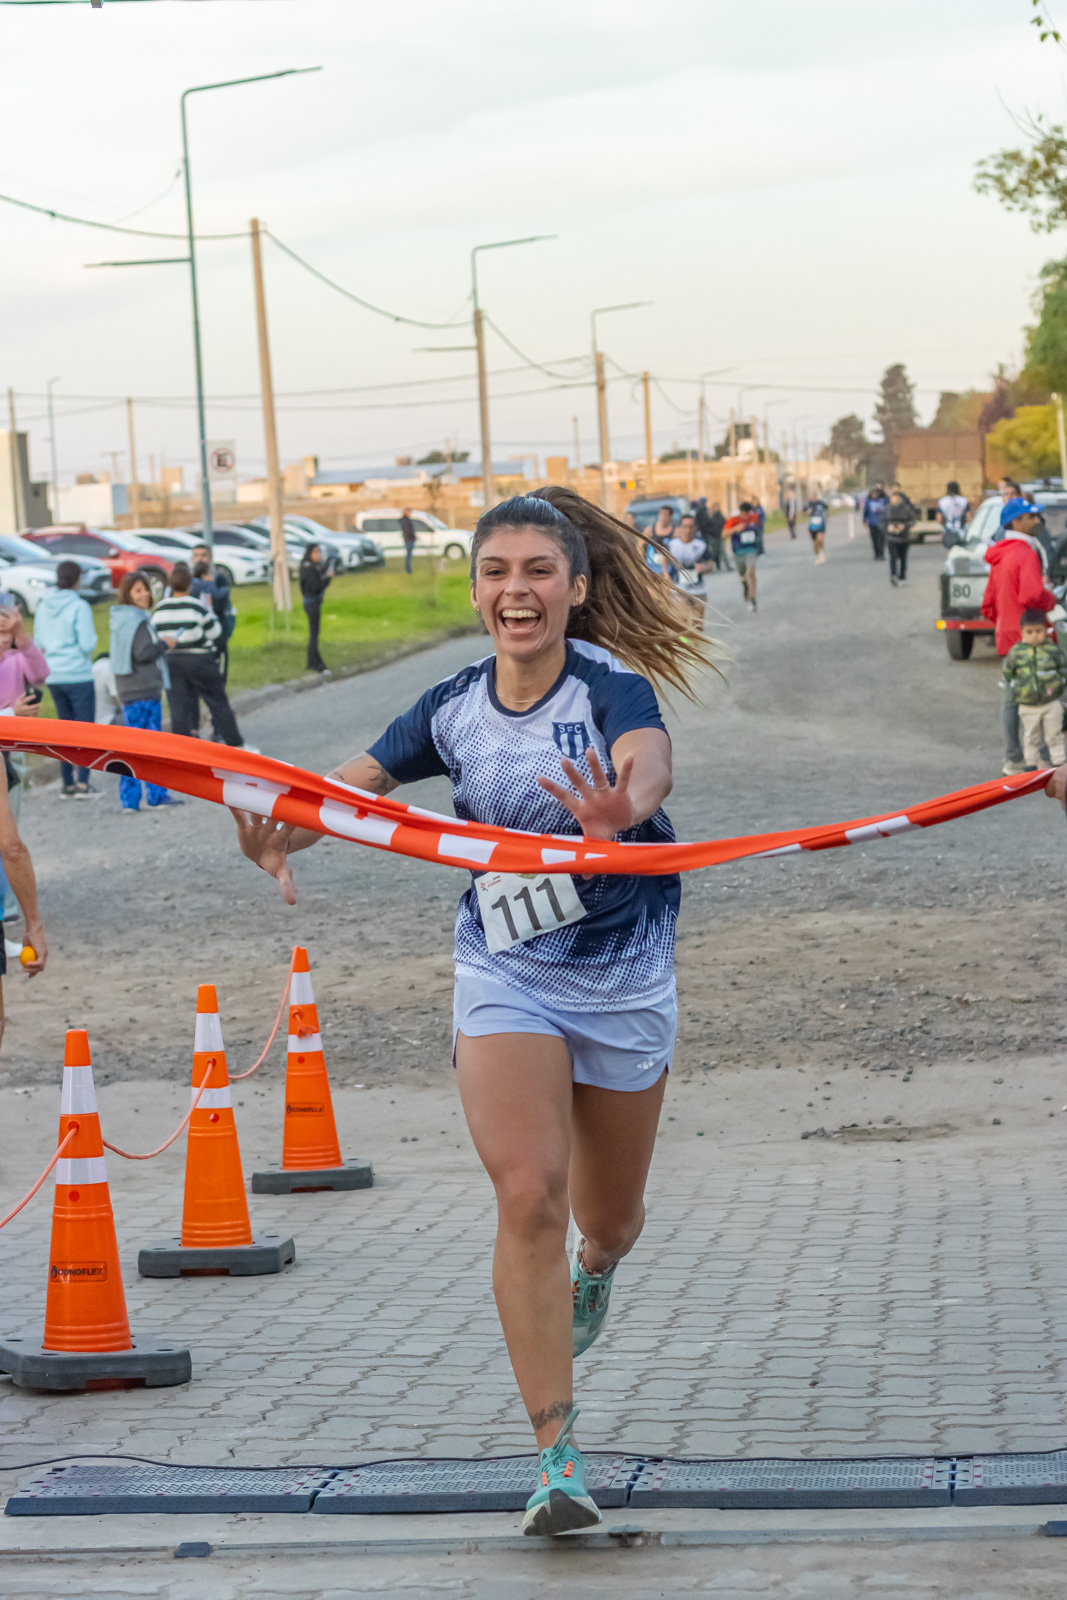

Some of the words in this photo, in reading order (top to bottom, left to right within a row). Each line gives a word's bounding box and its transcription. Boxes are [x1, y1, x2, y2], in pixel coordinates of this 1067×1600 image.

[217, 453, 228, 467] E
[953, 583, 971, 599] 80
[558, 724, 582, 734] SFC
[491, 877, 566, 942] 111
[57, 1268, 104, 1276] CONOFLEX
